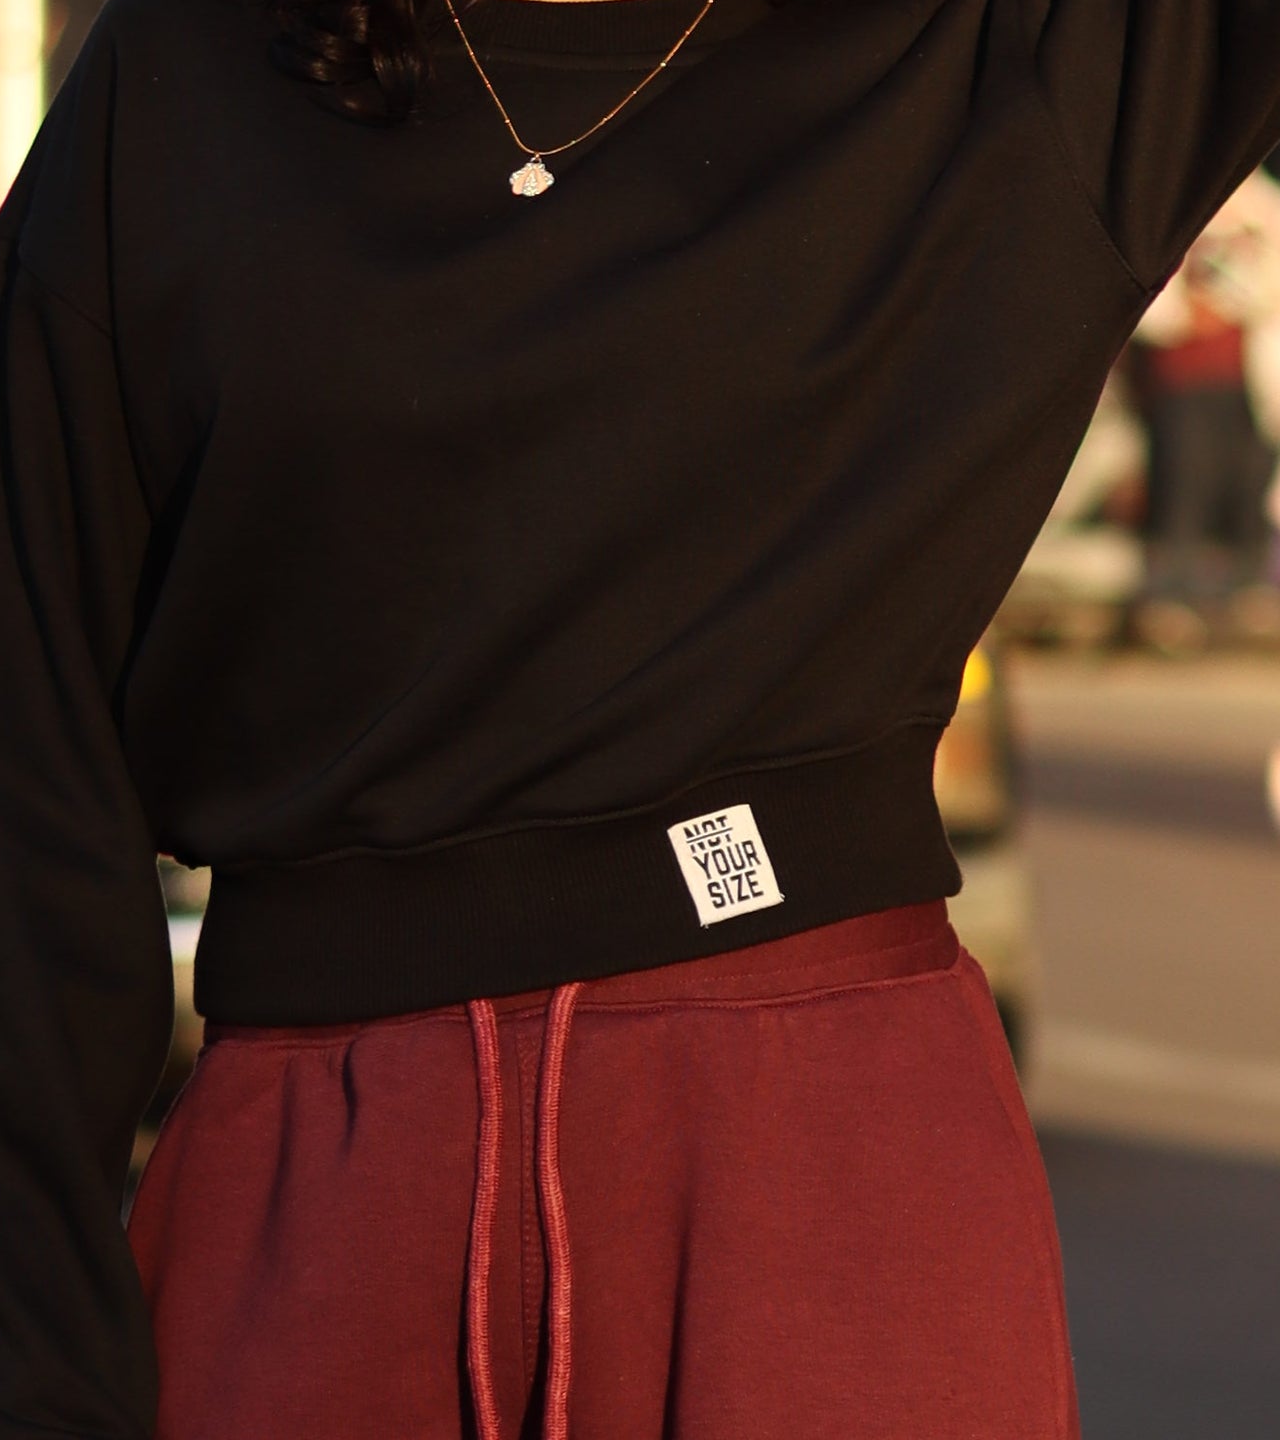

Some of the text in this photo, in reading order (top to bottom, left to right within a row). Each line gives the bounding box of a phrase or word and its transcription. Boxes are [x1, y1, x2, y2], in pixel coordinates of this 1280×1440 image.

[683, 814, 733, 853] NOT
[692, 839, 762, 880] YOUR
[706, 869, 765, 909] SIZE
